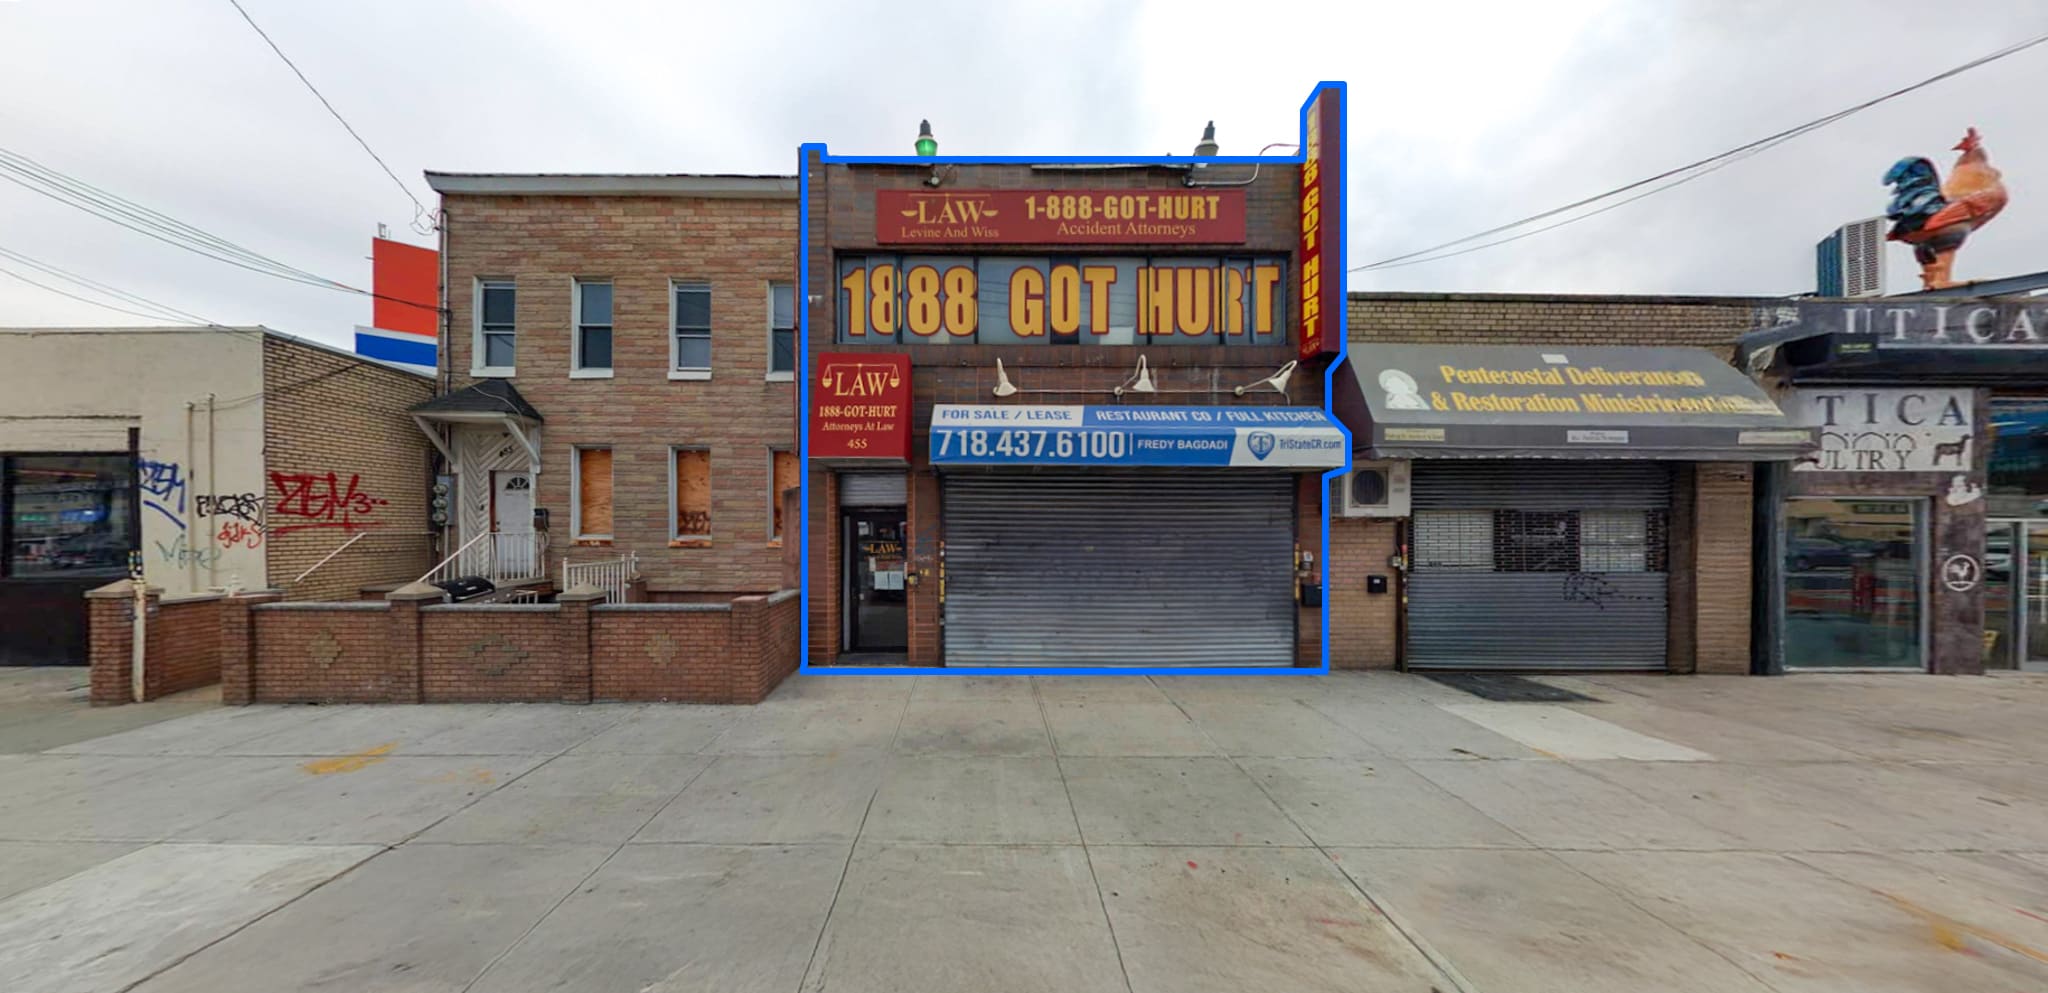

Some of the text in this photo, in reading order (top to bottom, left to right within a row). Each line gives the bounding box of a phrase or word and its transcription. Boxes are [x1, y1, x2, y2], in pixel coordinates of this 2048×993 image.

[916, 199, 986, 225] LAW
[1025, 196, 1220, 220] 1-888-GOT-HURT
[1303, 187, 1319, 251] GOT
[902, 226, 999, 238] Levine And Wiss
[1057, 221, 1196, 238] Accident Attorneys
[841, 264, 1280, 337] 1888 GOT HURT
[1303, 254, 1319, 338] HURT
[835, 371, 889, 396] LAW
[1439, 365, 1566, 385] Pentecostal
[818, 405, 897, 418] 1888-GOT-HURT
[1430, 392, 1449, 411] &
[1450, 392, 1581, 412] Restoration
[942, 410, 970, 420] FOR
[974, 410, 1010, 421] SALE
[1027, 410, 1073, 421] LEASE
[1096, 410, 1189, 422] RESTAURANT
[1191, 411, 1212, 422] CO
[1224, 410, 1265, 422] FULL
[1261, 410, 1329, 423] KITCHEN
[822, 421, 895, 433] Attorneys At Law
[847, 438, 868, 449] 455
[936, 429, 1126, 458] 718.437.6100
[1137, 439, 1229, 450] FREDY BAGDADI
